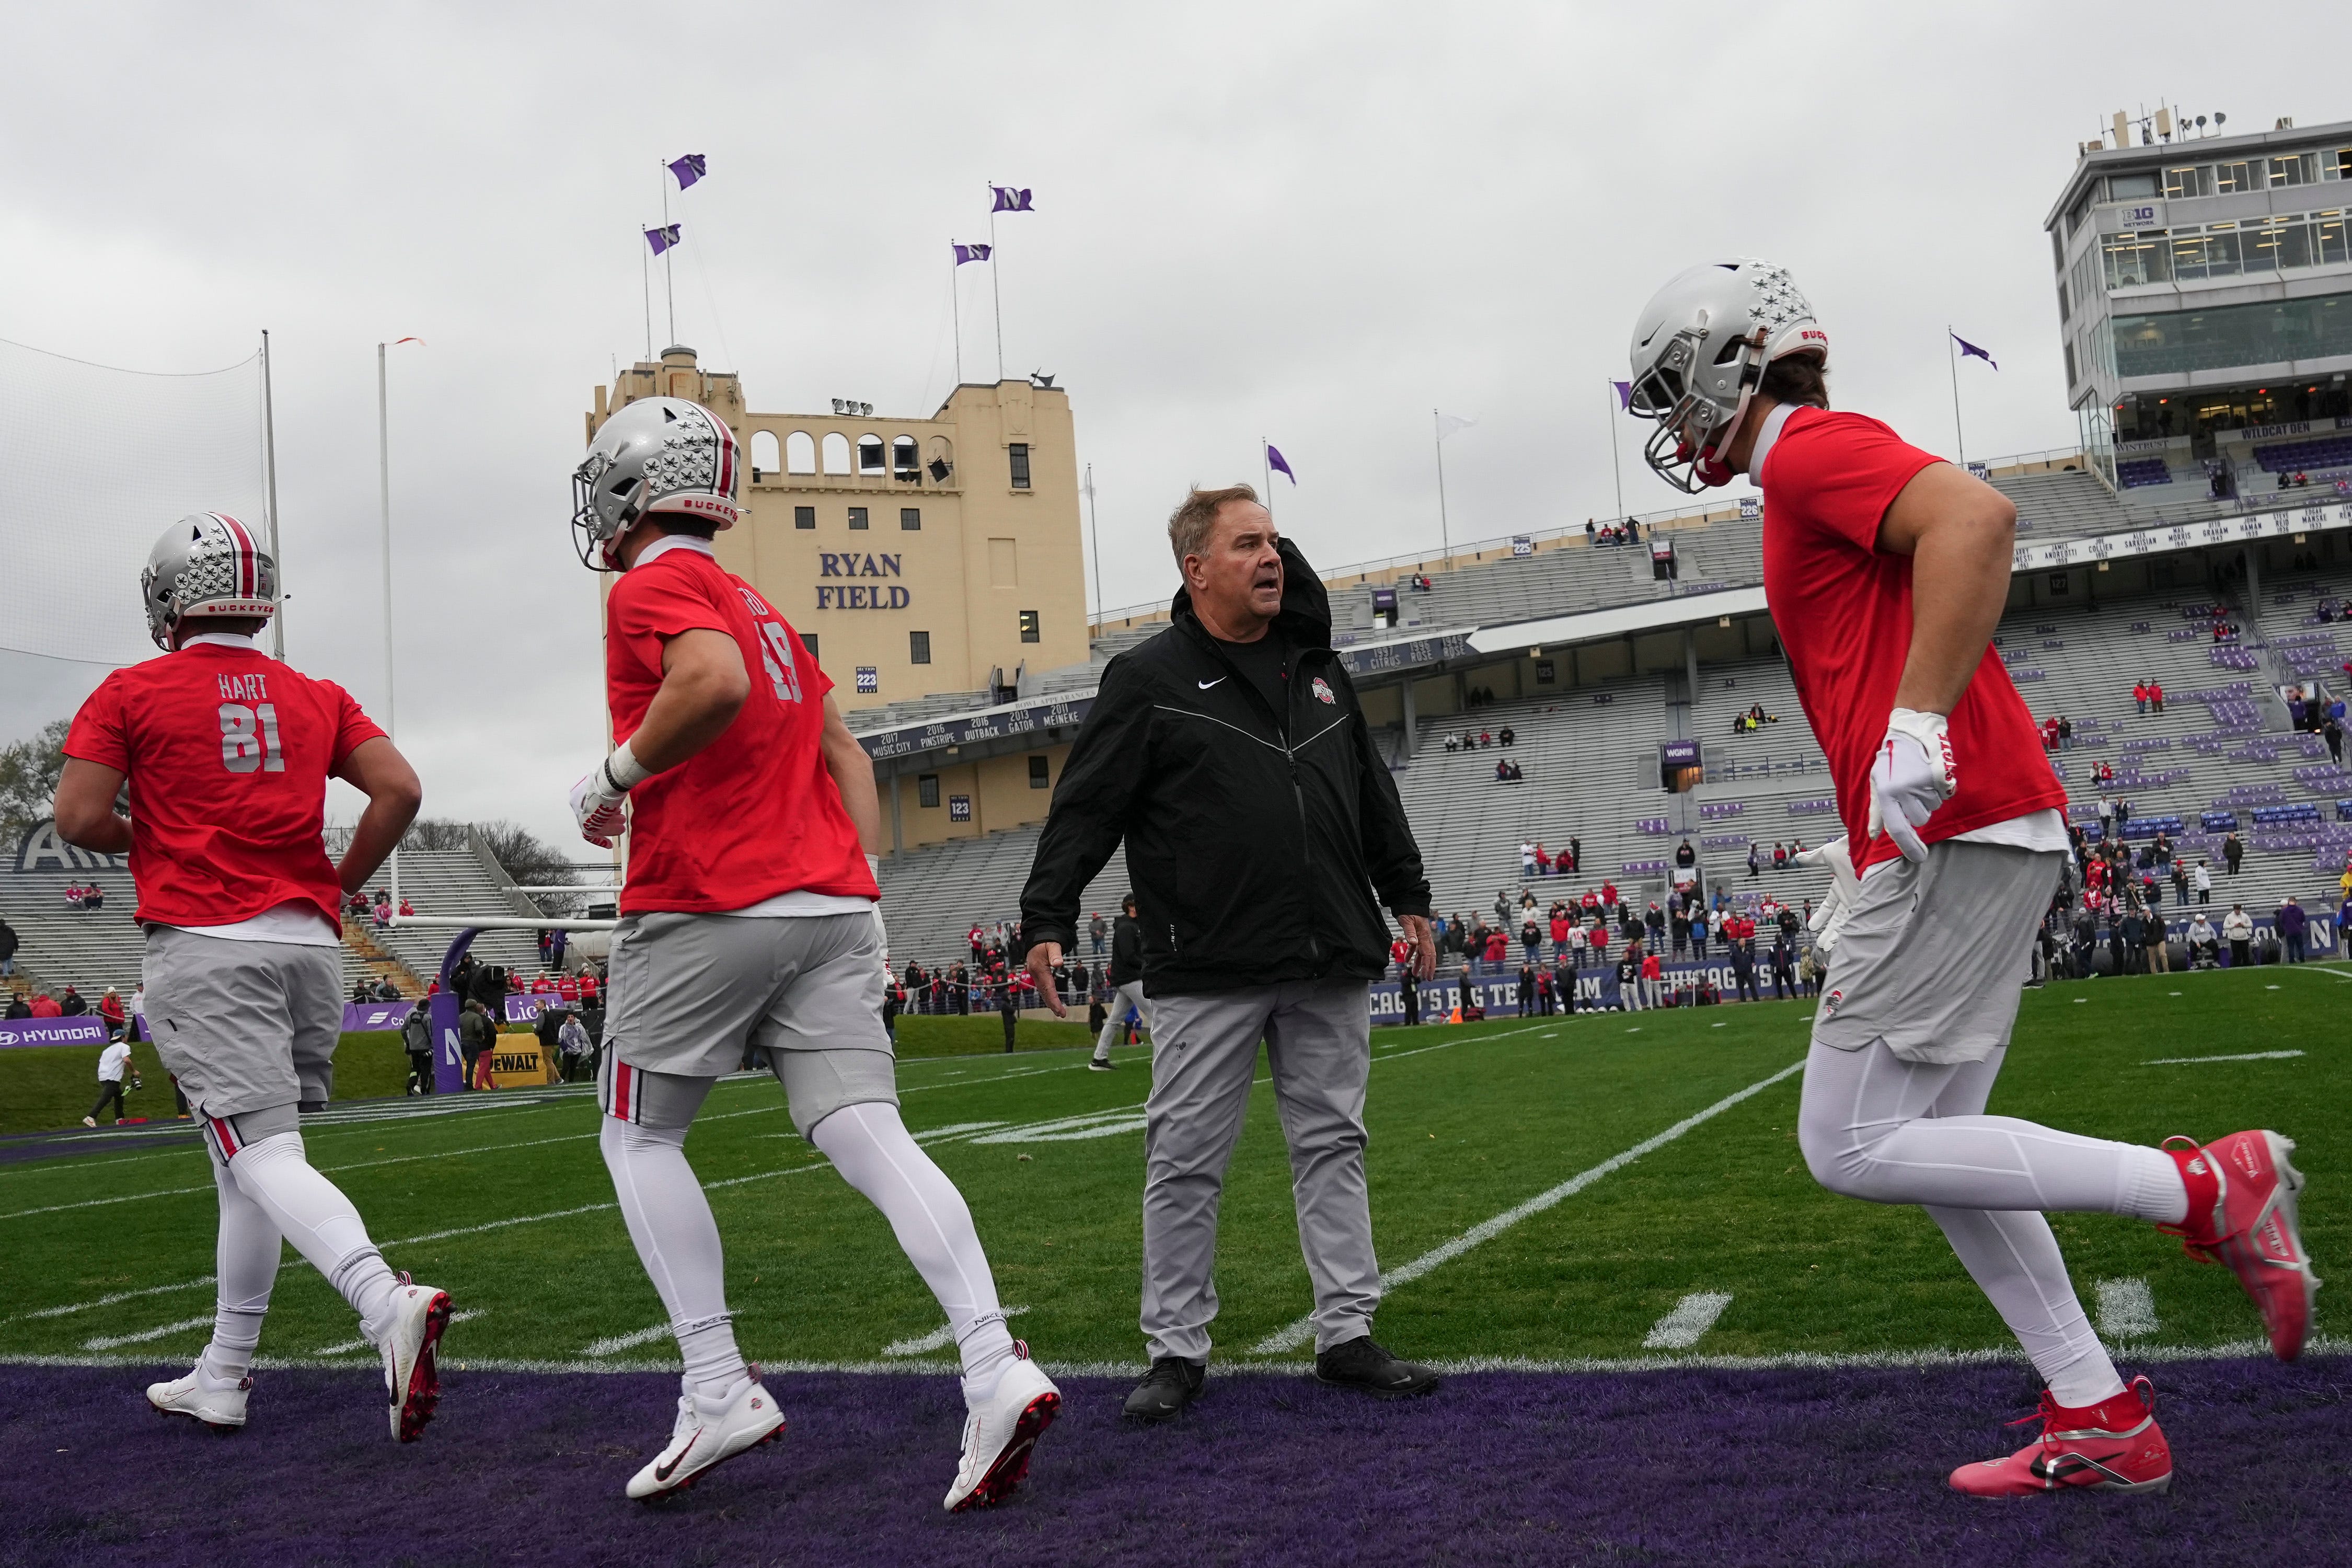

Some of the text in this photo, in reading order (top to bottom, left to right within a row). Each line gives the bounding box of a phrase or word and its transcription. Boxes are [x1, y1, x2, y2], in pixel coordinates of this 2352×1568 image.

[1004, 188, 1021, 209] N
[2242, 421, 2310, 440] WILDCAT DEN
[2116, 440, 2169, 452] WINTRUST
[1741, 505, 1758, 516] 226
[2302, 514, 2327, 523] MANSKE
[2203, 527, 2229, 537] GRAHAM
[2240, 523, 2262, 532] HAMAN
[2125, 537, 2157, 548] SARKISIAN
[2169, 532, 2191, 541] MORRIS
[1514, 543, 1530, 554] 225
[2045, 549, 2077, 559] ANDREOTTI
[2089, 543, 2113, 554] COLLIER
[820, 553, 902, 577] RYAN
[815, 586, 910, 609] FIELD
[1410, 641, 1431, 653] 1996
[1442, 635, 1463, 648] 1949
[1374, 646, 1393, 658] 1997
[1411, 649, 1434, 663] ROSE
[1443, 644, 1466, 658] ROSE
[1370, 654, 1401, 670] CITRUS
[218, 673, 267, 700] HART
[857, 674, 877, 686] 223
[1016, 699, 1036, 709] BOWL
[1051, 703, 1068, 716] 2011
[971, 717, 989, 728] 2016
[1009, 710, 1030, 722] 2013
[1043, 711, 1079, 727] MEINEKE
[926, 724, 945, 736] 2016
[1008, 719, 1035, 733] GATOR
[218, 702, 285, 773] 81
[881, 732, 898, 745] 2017
[920, 732, 956, 748] PINSTRIPE
[965, 726, 999, 741] OUTBACK
[872, 741, 911, 757] MUSIC CITY
[952, 802, 969, 814] 123
[2310, 919, 2332, 950] N
[1447, 985, 1484, 1010] BG
[1490, 982, 1526, 1007] TE
[23, 1027, 102, 1042] HYUNDAI
